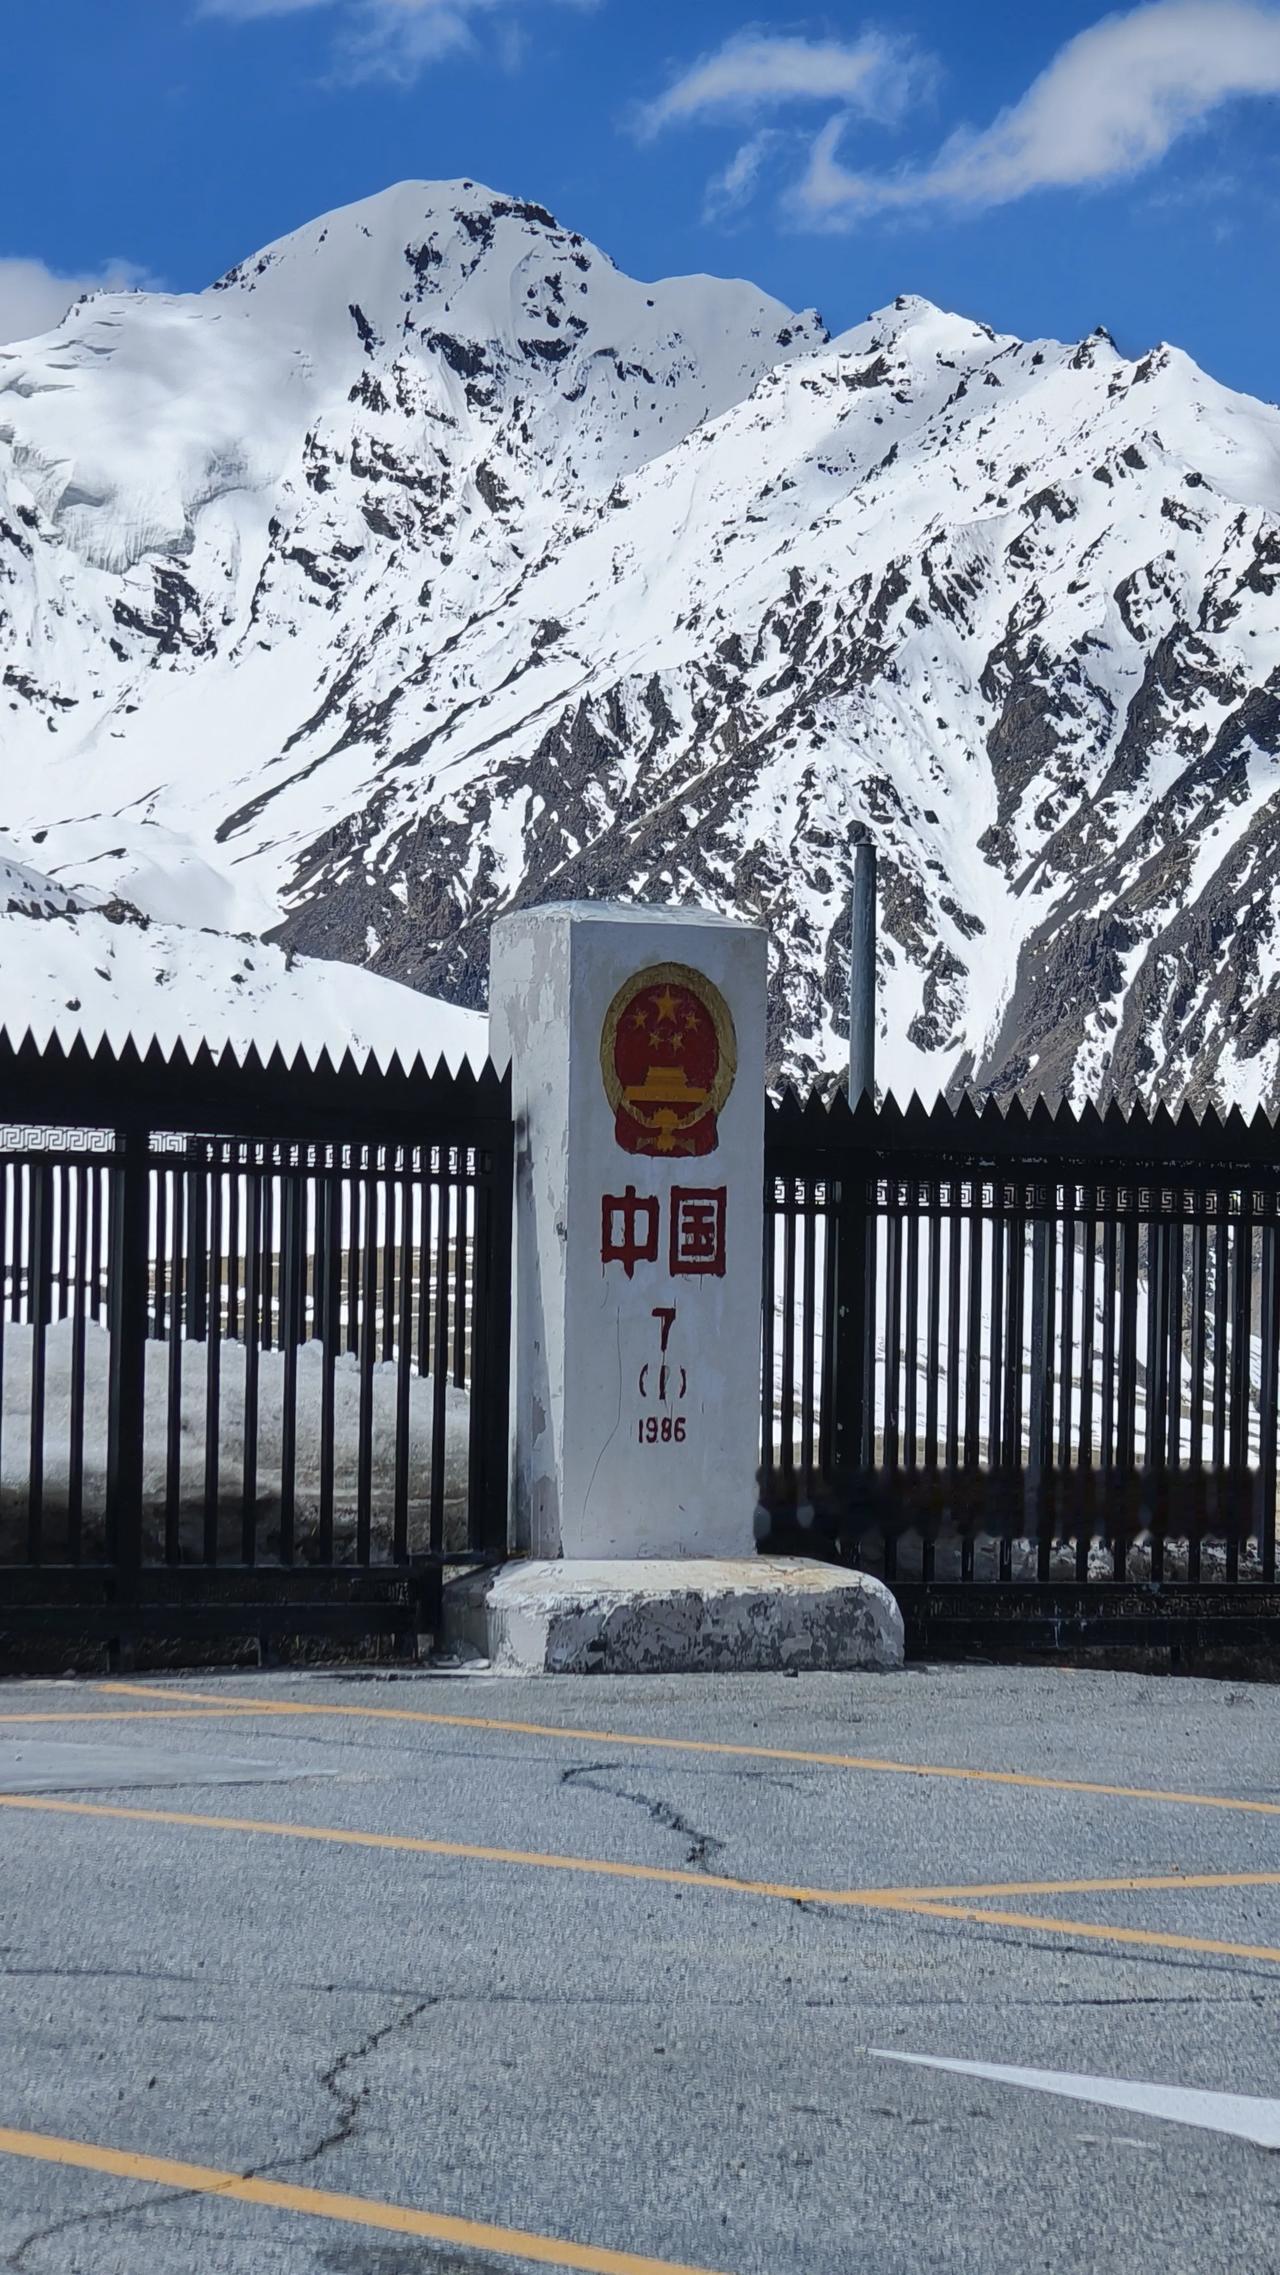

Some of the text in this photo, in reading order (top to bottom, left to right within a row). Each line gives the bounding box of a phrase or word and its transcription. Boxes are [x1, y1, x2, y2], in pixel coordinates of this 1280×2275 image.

[601, 1185, 727, 1279] 中国
[651, 1307, 676, 1352] 7
[638, 1416, 686, 1443] 1986
